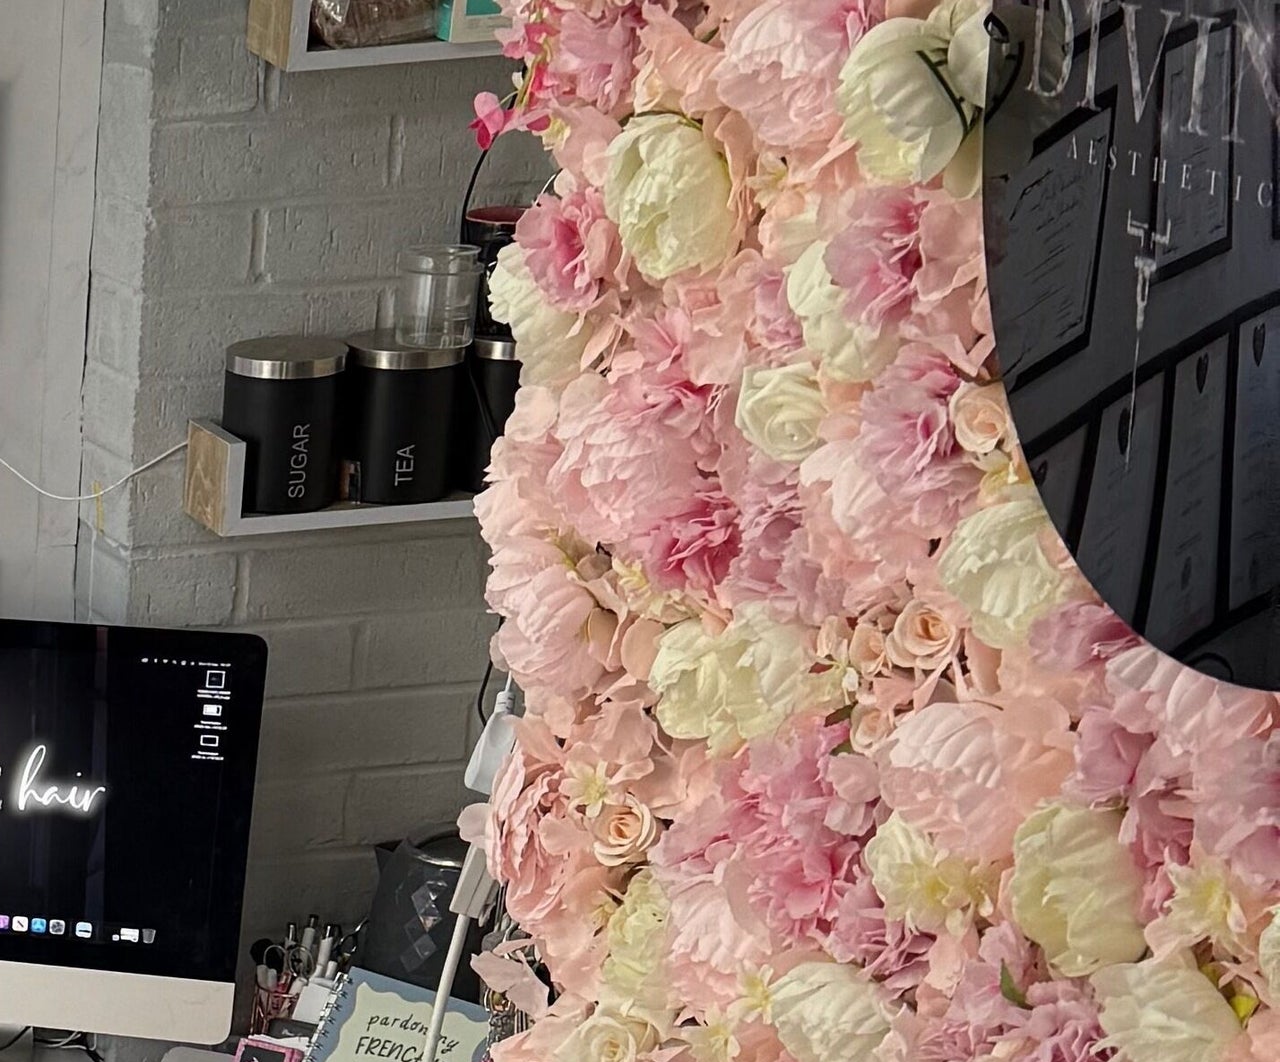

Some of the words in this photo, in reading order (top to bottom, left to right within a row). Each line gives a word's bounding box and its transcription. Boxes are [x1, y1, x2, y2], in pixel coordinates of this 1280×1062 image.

[287, 422, 311, 498] SUGAR
[394, 444, 416, 486] TEA
[15, 743, 106, 813] hair
[366, 1013, 429, 1035] pardon
